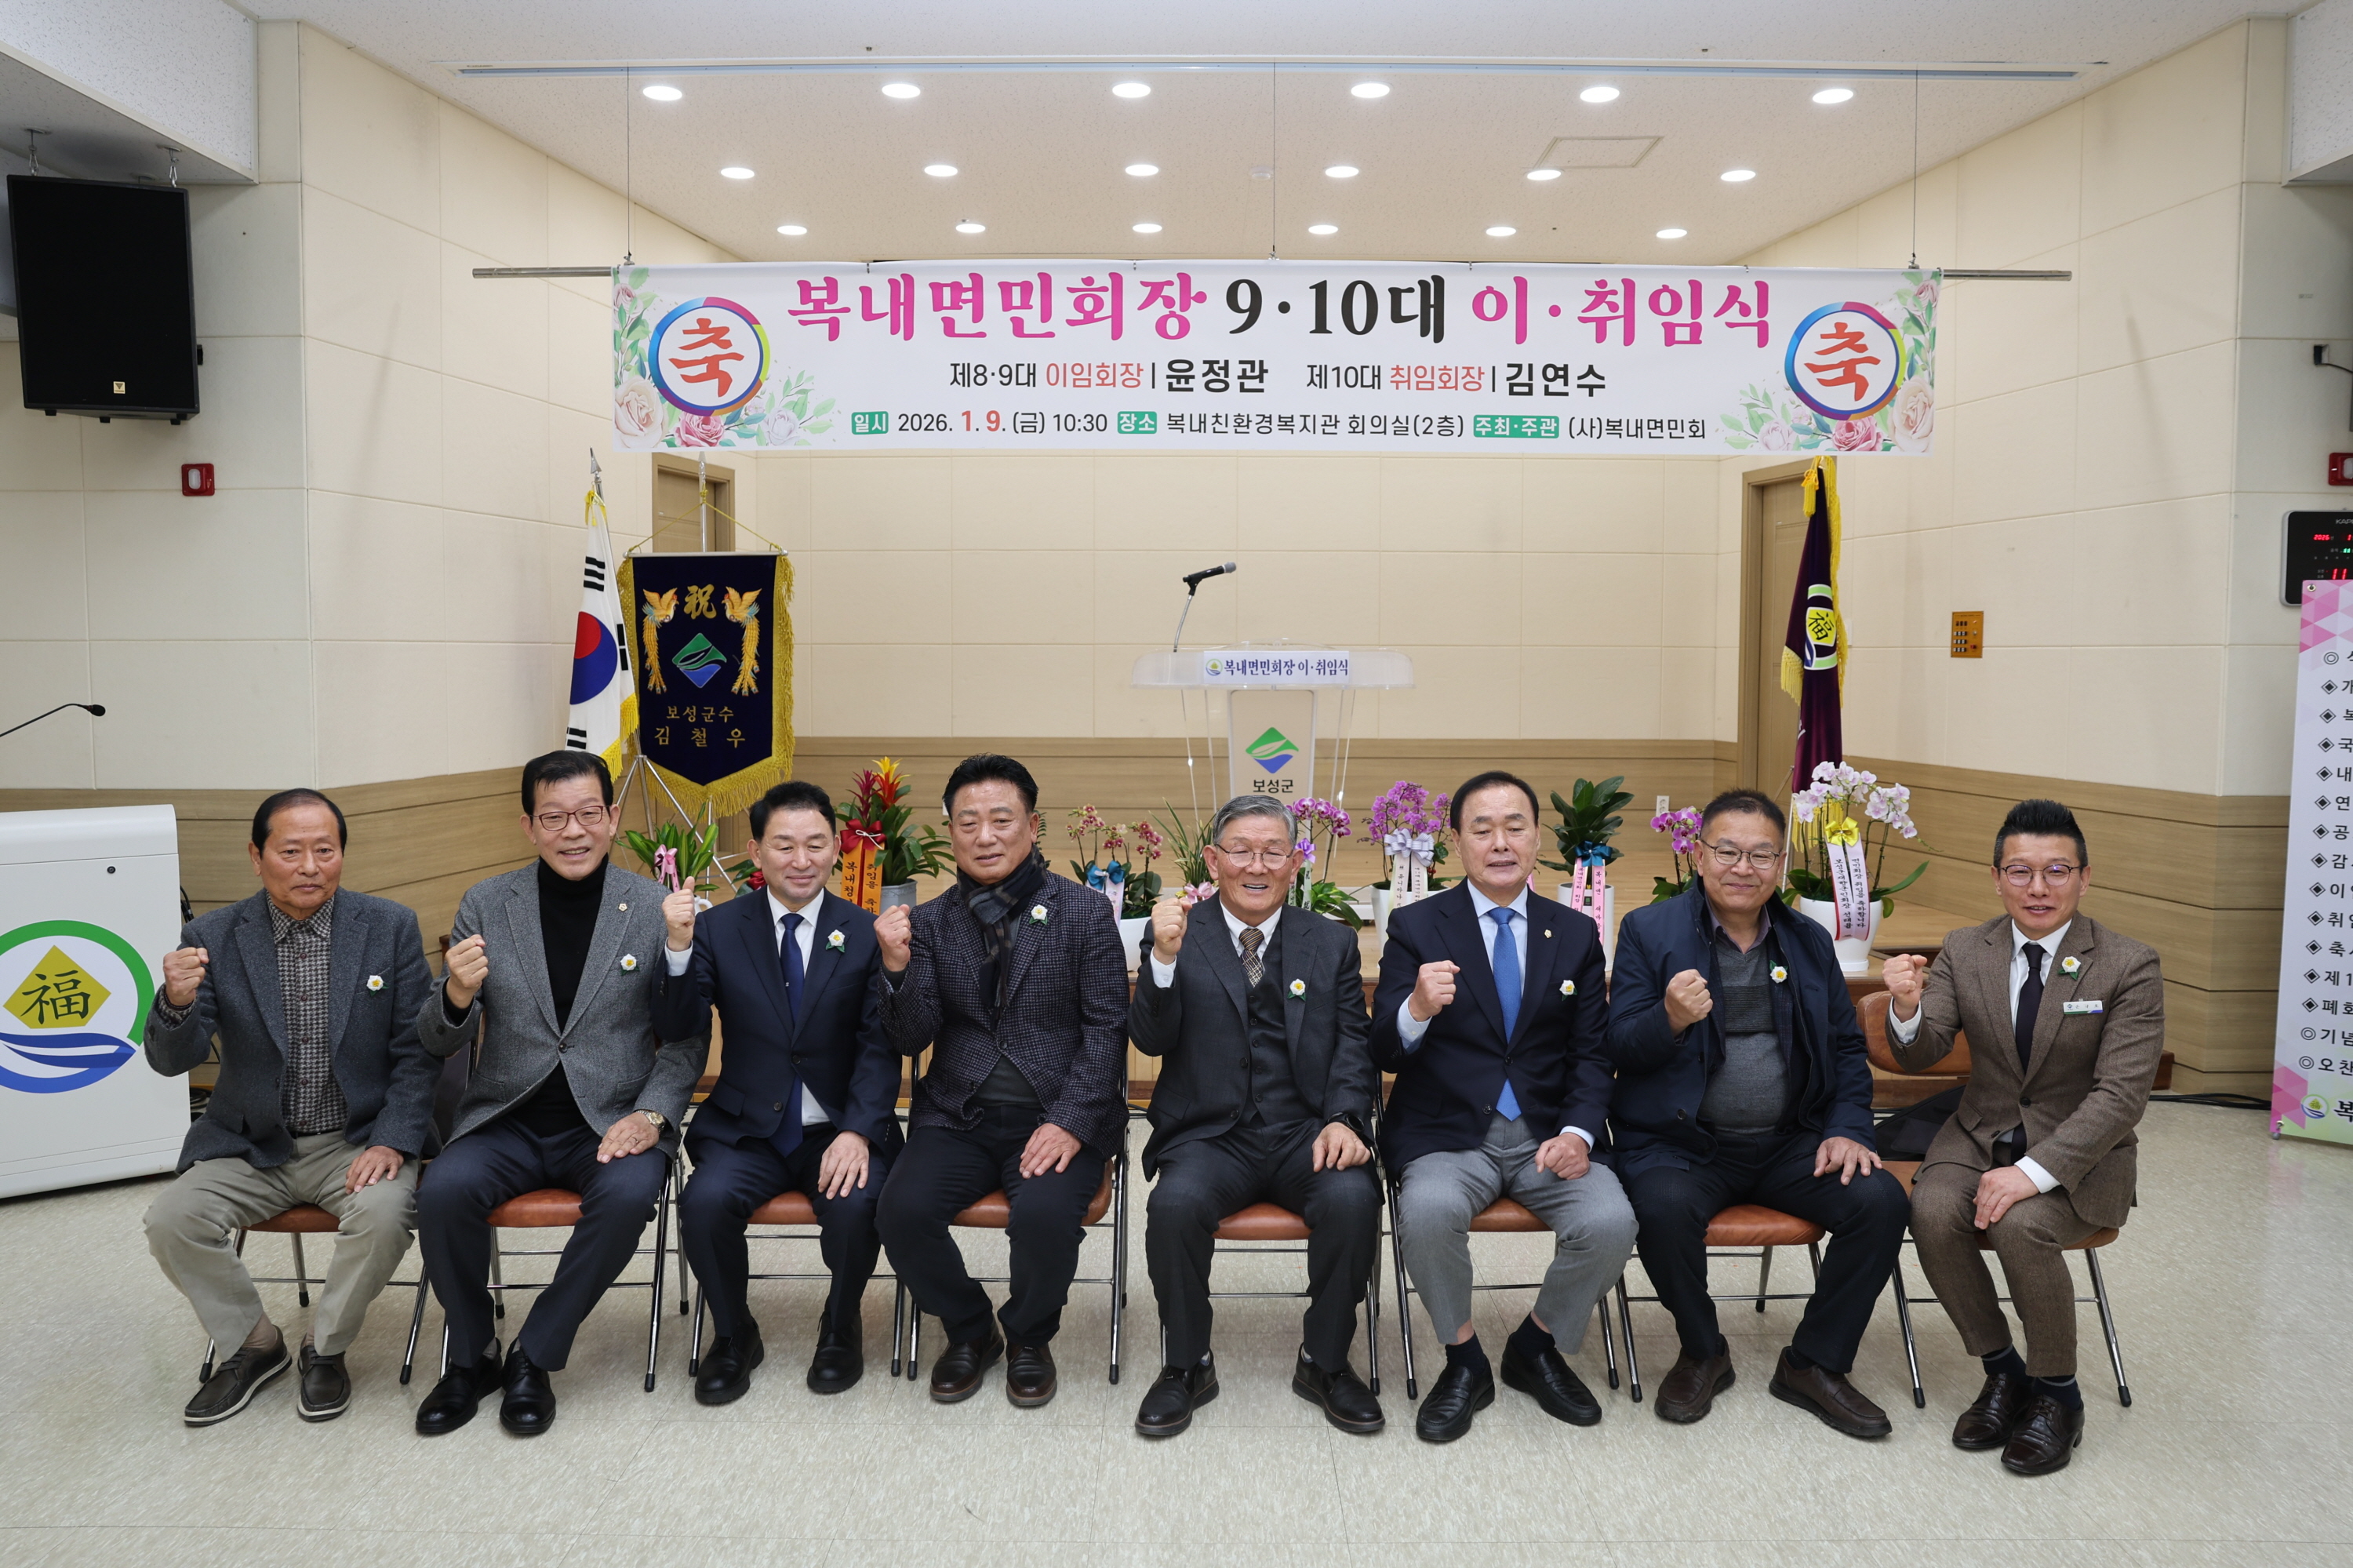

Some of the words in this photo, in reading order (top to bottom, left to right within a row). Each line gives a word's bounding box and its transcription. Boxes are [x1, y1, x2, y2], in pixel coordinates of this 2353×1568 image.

[787, 273, 1209, 341] 복내면민회장
[1226, 275, 1445, 344] 9·10대
[1472, 276, 1769, 349] 이·취임식
[668, 318, 745, 398] 축
[1804, 322, 1880, 402] 축
[951, 362, 1036, 388] 제8·9대
[1046, 362, 1144, 388] 이임회장
[1166, 359, 1269, 394] 윤정관
[1306, 364, 1381, 391] 제10대
[1390, 364, 1486, 392] 취임회장
[1505, 362, 1606, 398] 김연수
[853, 413, 886, 432] 일시
[898, 413, 954, 432] 2026.
[962, 410, 980, 432] 1.
[987, 410, 1006, 432] 9.
[1013, 411, 1046, 435] (금)
[1053, 413, 1107, 432] 10:30
[1119, 413, 1155, 433] 장소
[1166, 413, 1340, 435] 복내친환경복지관
[1347, 413, 1464, 438] 회의실(2층)
[1475, 417, 1558, 438] 주최·주관
[1569, 417, 1706, 440] (사)복내면민회
[684, 584, 717, 620] 祝
[1809, 612, 1834, 640] 福
[1224, 659, 1295, 676] 복내면민회장
[1298, 659, 1348, 676] 이·취임식
[667, 706, 734, 723] 보성군수
[1253, 779, 1294, 794] 보성군
[2337, 766, 2352, 782] 내
[2336, 796, 2350, 811] 연
[2332, 854, 2353, 870] 감
[844, 861, 857, 902] 복내청
[2329, 883, 2353, 899] 이
[20, 970, 91, 1025] 福
